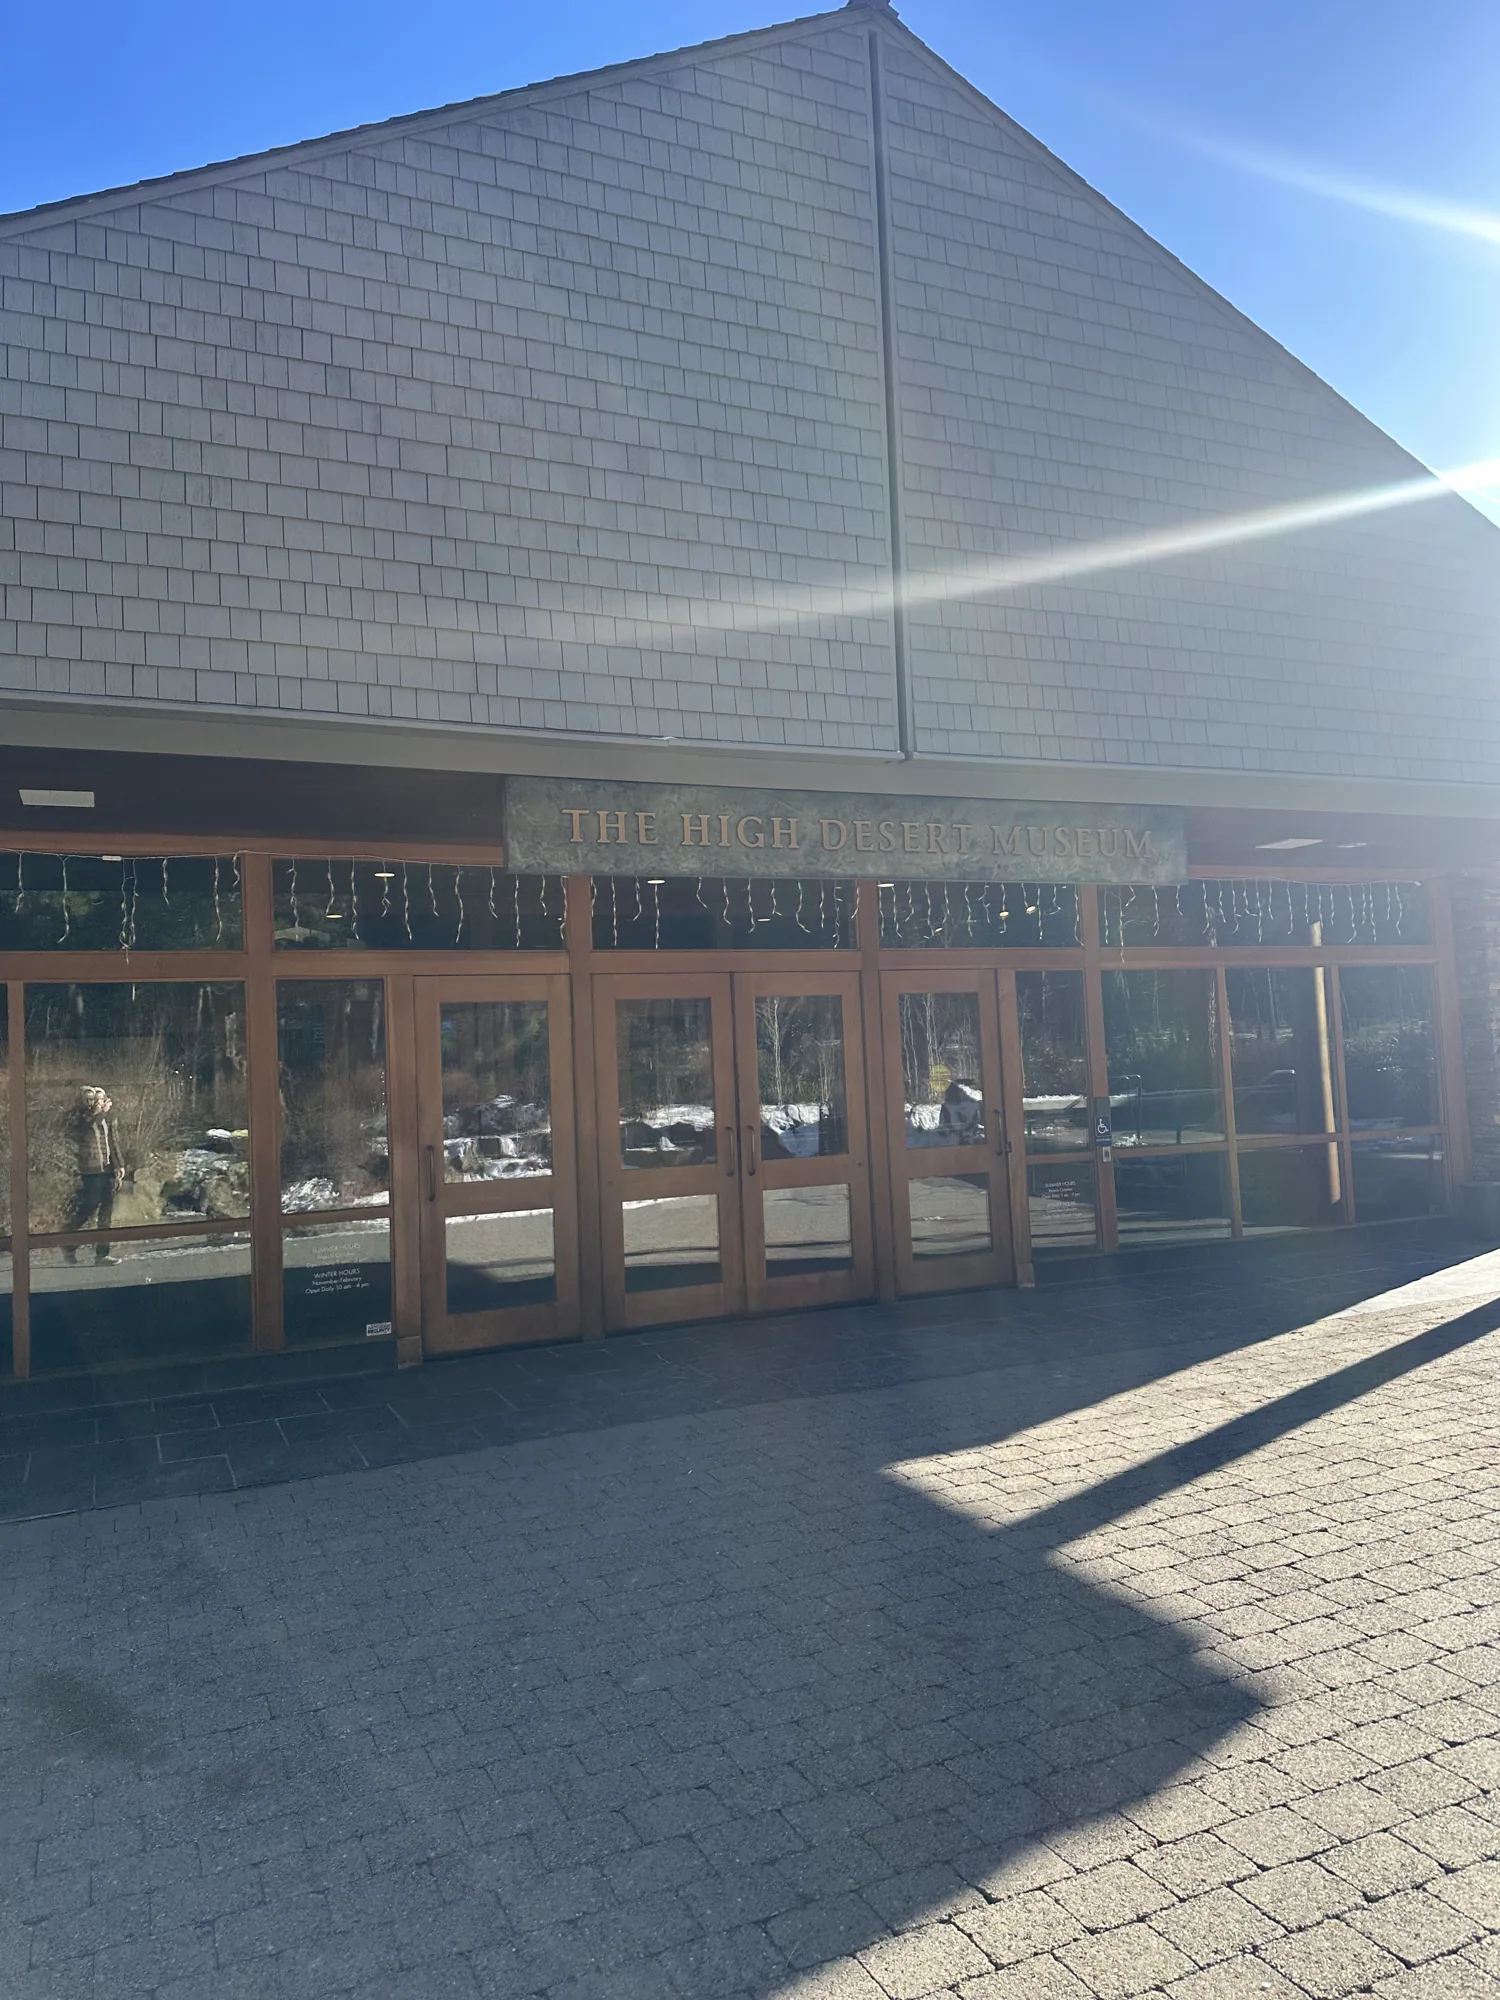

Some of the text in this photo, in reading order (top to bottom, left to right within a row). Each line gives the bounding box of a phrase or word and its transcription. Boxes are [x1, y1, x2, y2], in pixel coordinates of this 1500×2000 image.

[561, 809, 1154, 858] THE HIGH DESERT MUSEUM
[313, 1270, 338, 1278] WINTER
